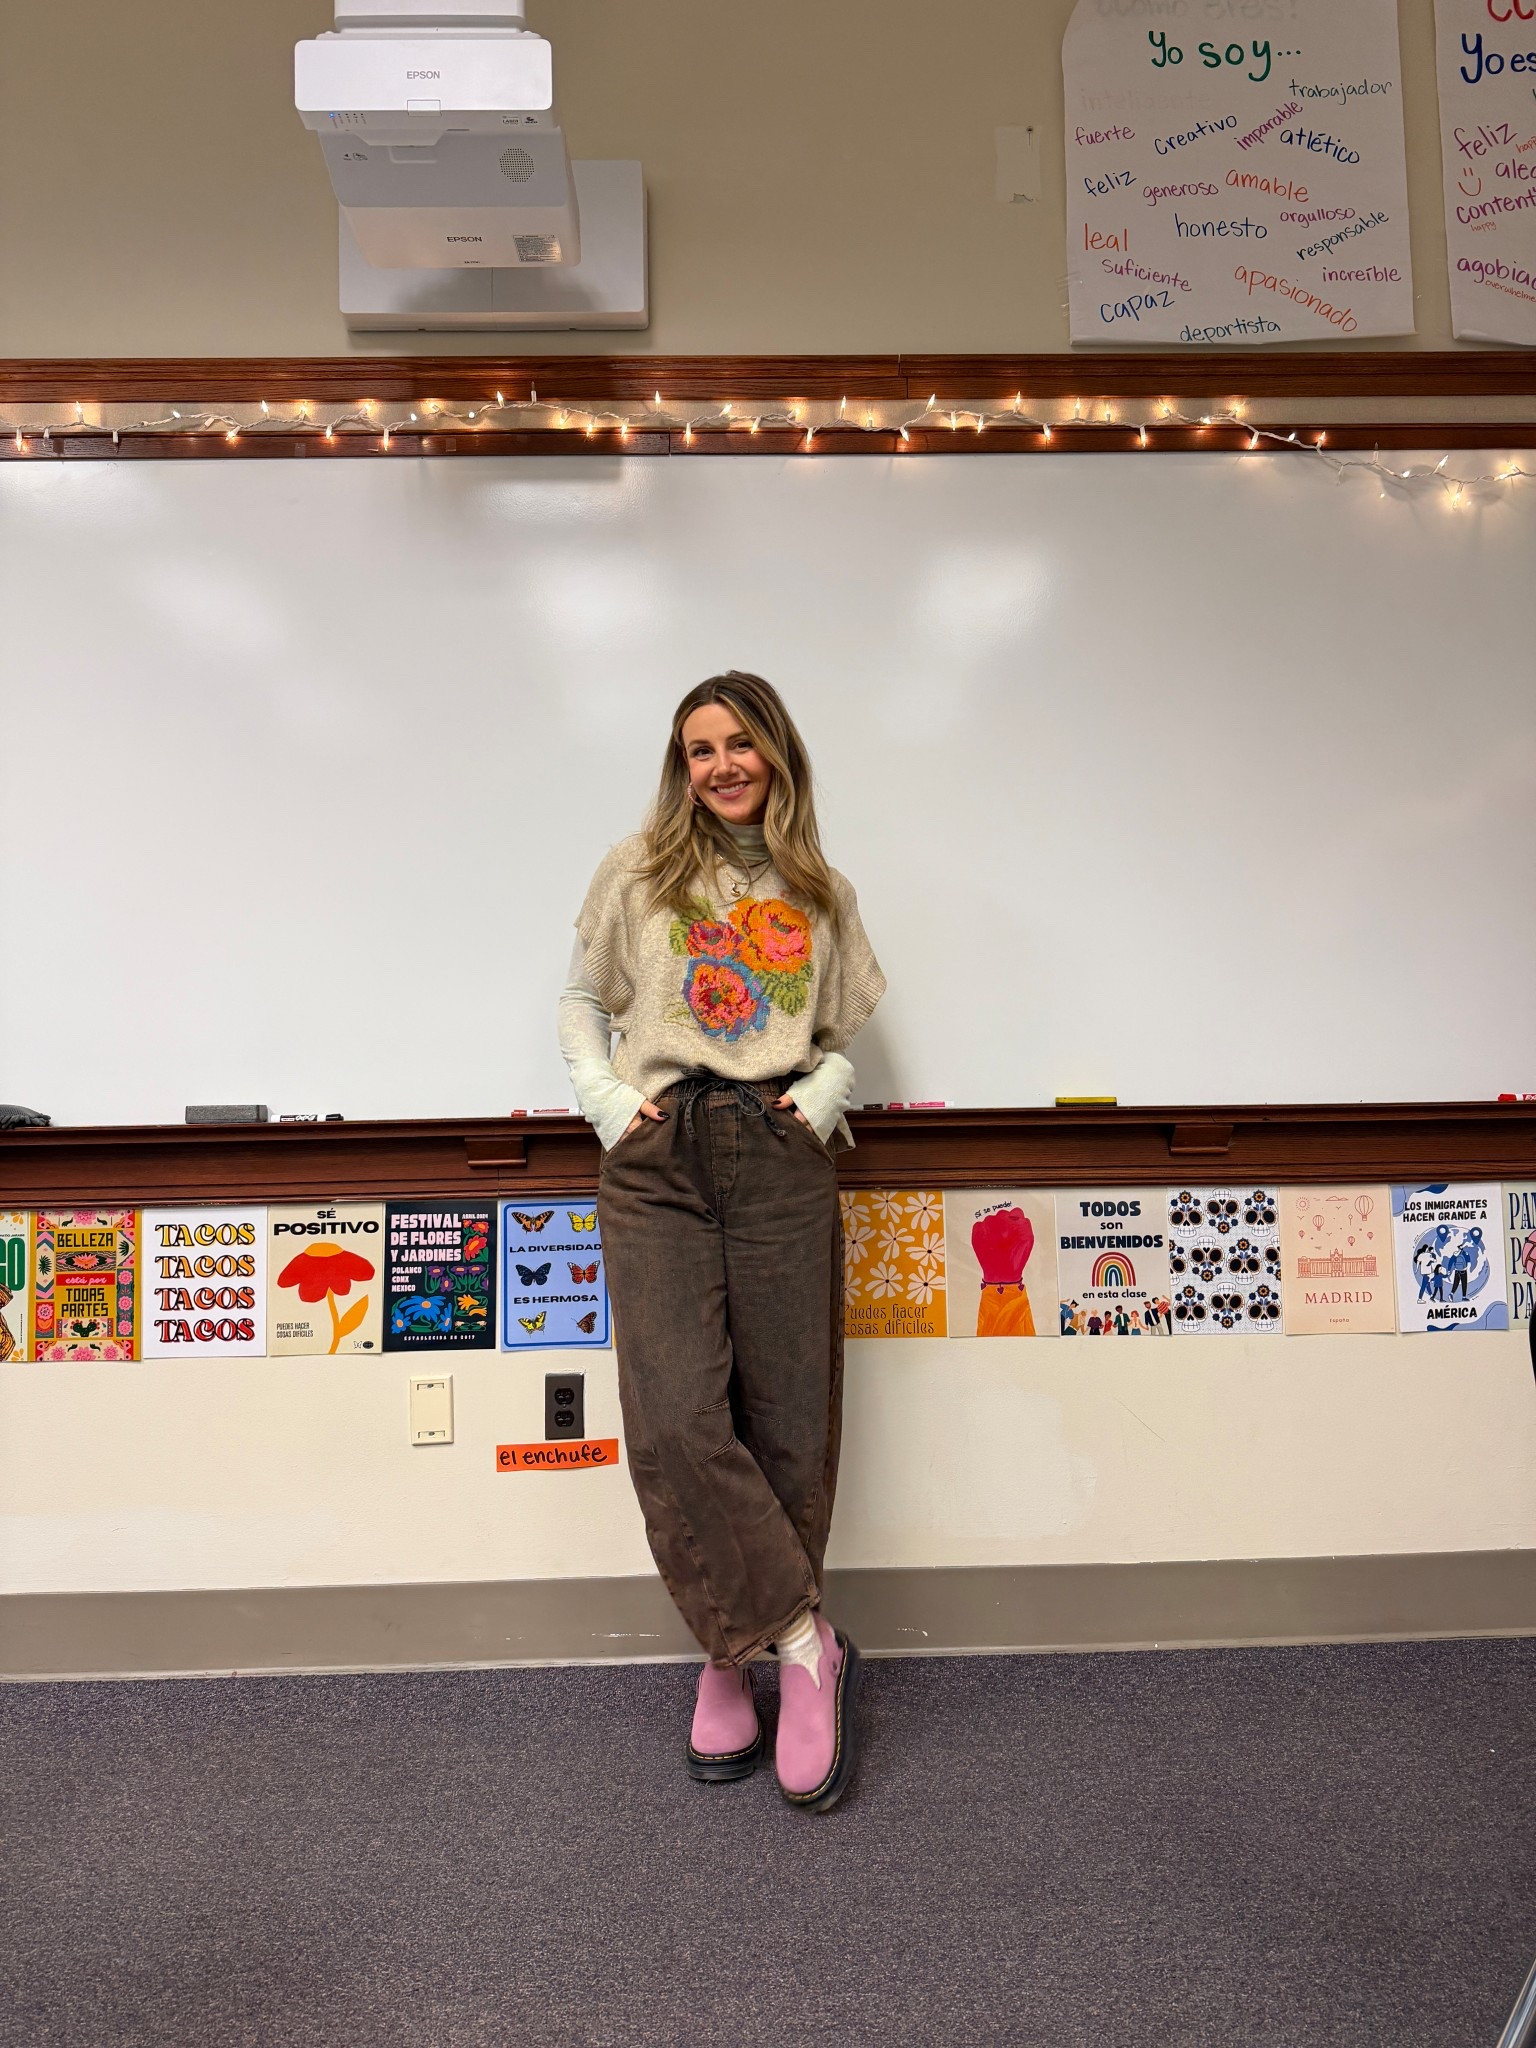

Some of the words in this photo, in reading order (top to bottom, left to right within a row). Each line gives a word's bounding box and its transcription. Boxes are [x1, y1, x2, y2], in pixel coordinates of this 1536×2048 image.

[1148, 30, 1184, 67] Yo
[406, 71, 441, 80] EPSON
[1289, 79, 1393, 105] trabajador
[1234, 101, 1303, 150] imparable
[1075, 125, 1136, 146] fuerte
[1454, 123, 1518, 160] feliz
[1280, 127, 1360, 164] atlético
[1084, 171, 1137, 197] feliz
[1225, 169, 1309, 203] amable
[1142, 182, 1219, 207] generoso
[1280, 207, 1356, 228] orgulloso
[1174, 213, 1268, 239] honesto
[1470, 221, 1497, 233] happy
[1084, 223, 1128, 252] leal
[1296, 211, 1390, 260] responsable
[1322, 266, 1402, 282] increíble
[1234, 265, 1358, 332] apasionado
[1179, 316, 1281, 343] deportista
[1079, 1200, 1142, 1217] TODOS
[1404, 1202, 1422, 1211] LOS
[1424, 1199, 1488, 1210] INMIGRANTES
[317, 1208, 336, 1219] SÉ
[390, 1213, 461, 1229] FESTIVAL
[1403, 1212, 1435, 1222] HACEN
[1438, 1211, 1477, 1220] GRANDE
[1480, 1211, 1487, 1219] A
[273, 1221, 379, 1236] POSITIVO
[1100, 1220, 1123, 1230] son
[57, 1233, 114, 1247] BELLEZA
[155, 1223, 256, 1247] TACOS
[390, 1231, 407, 1246] DE
[410, 1231, 461, 1246] FLORES
[1060, 1234, 1164, 1249] BIENVENIDOS
[390, 1249, 398, 1262] Y
[400, 1249, 461, 1262] JARDINES
[528, 1244, 602, 1253] DIVERSIDAD
[155, 1254, 256, 1278] TACOS
[391, 1266, 422, 1274] POLANCO
[88, 1277, 107, 1286] por
[65, 1288, 105, 1302] TODAS
[155, 1286, 256, 1311] TACOS
[532, 1294, 599, 1304] HERMOSA
[1082, 1291, 1095, 1299] en
[1097, 1289, 1119, 1299] esta
[1121, 1288, 1147, 1298] clase
[1304, 1291, 1373, 1304] MADRID
[61, 1303, 109, 1317] PARTES
[892, 1303, 928, 1319] hacer
[1426, 1305, 1478, 1320] AMÉRICA
[155, 1318, 256, 1342] TACOS
[276, 1323, 293, 1331] PUEDES
[294, 1322, 309, 1330] HACER
[844, 1322, 879, 1336] cosas
[499, 1450, 517, 1466] el
[522, 1443, 608, 1465] enchufe
